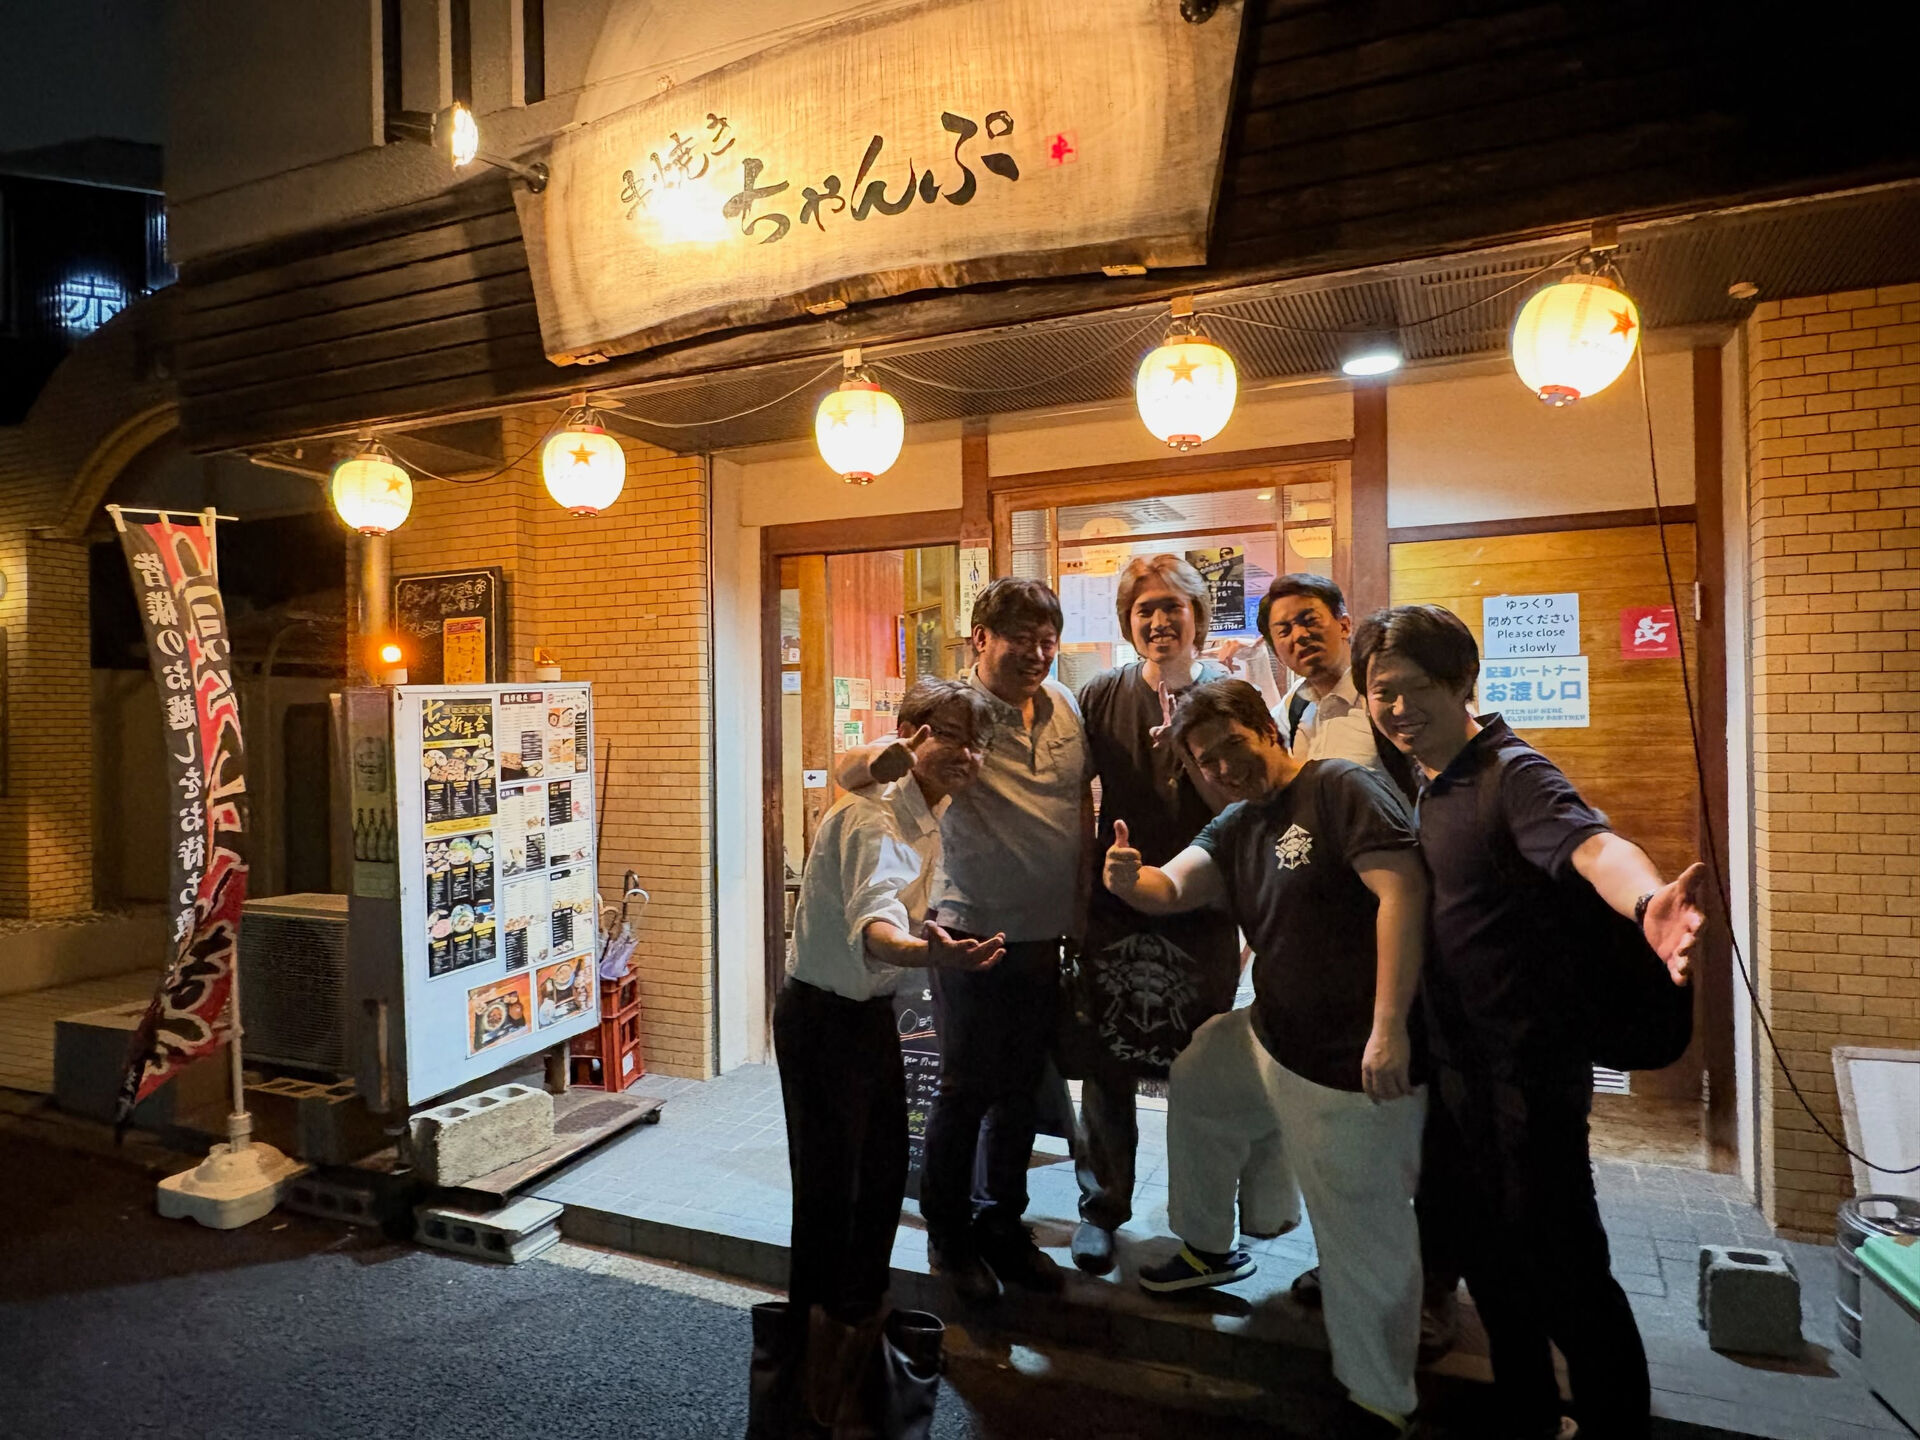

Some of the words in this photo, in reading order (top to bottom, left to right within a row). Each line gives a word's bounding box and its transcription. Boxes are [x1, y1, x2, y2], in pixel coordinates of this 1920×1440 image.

[722, 110, 1021, 244] ちゃんぷ
[1506, 598, 1554, 609] ゆっくり
[1487, 613, 1575, 627] 閉めてください
[1497, 629, 1534, 639] Please
[1536, 627, 1566, 638] close
[1508, 643, 1519, 654] it
[1520, 642, 1557, 655] slowly
[1485, 680, 1582, 702] お渡し口
